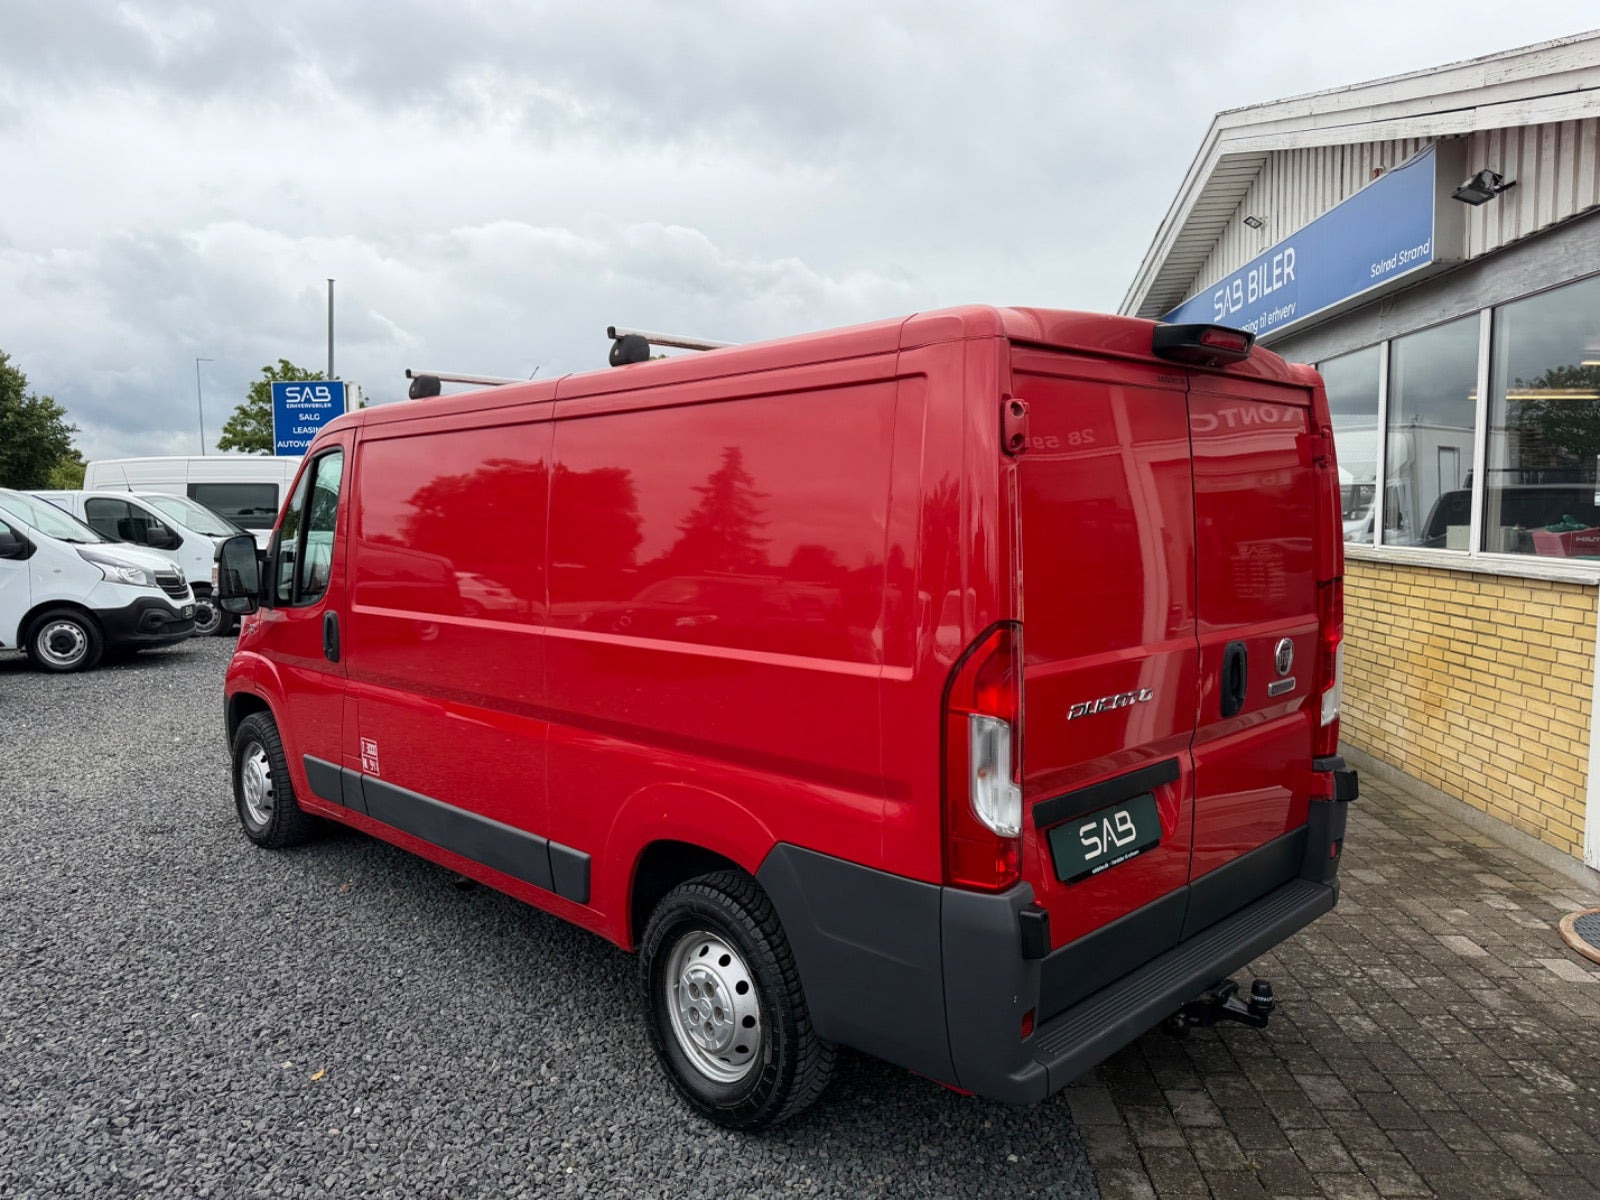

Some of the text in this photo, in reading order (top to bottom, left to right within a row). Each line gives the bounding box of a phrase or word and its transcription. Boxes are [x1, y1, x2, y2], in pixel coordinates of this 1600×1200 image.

[1370, 237, 1431, 278] Solrød Strand
[1214, 247, 1295, 323] SAB BILER
[1267, 302, 1296, 325] erhverv
[285, 386, 332, 402] SAB
[299, 413, 320, 421] SALG
[277, 440, 310, 448] AUTOVA
[1066, 688, 1154, 720] DUCATO
[1079, 810, 1137, 861] SAB
